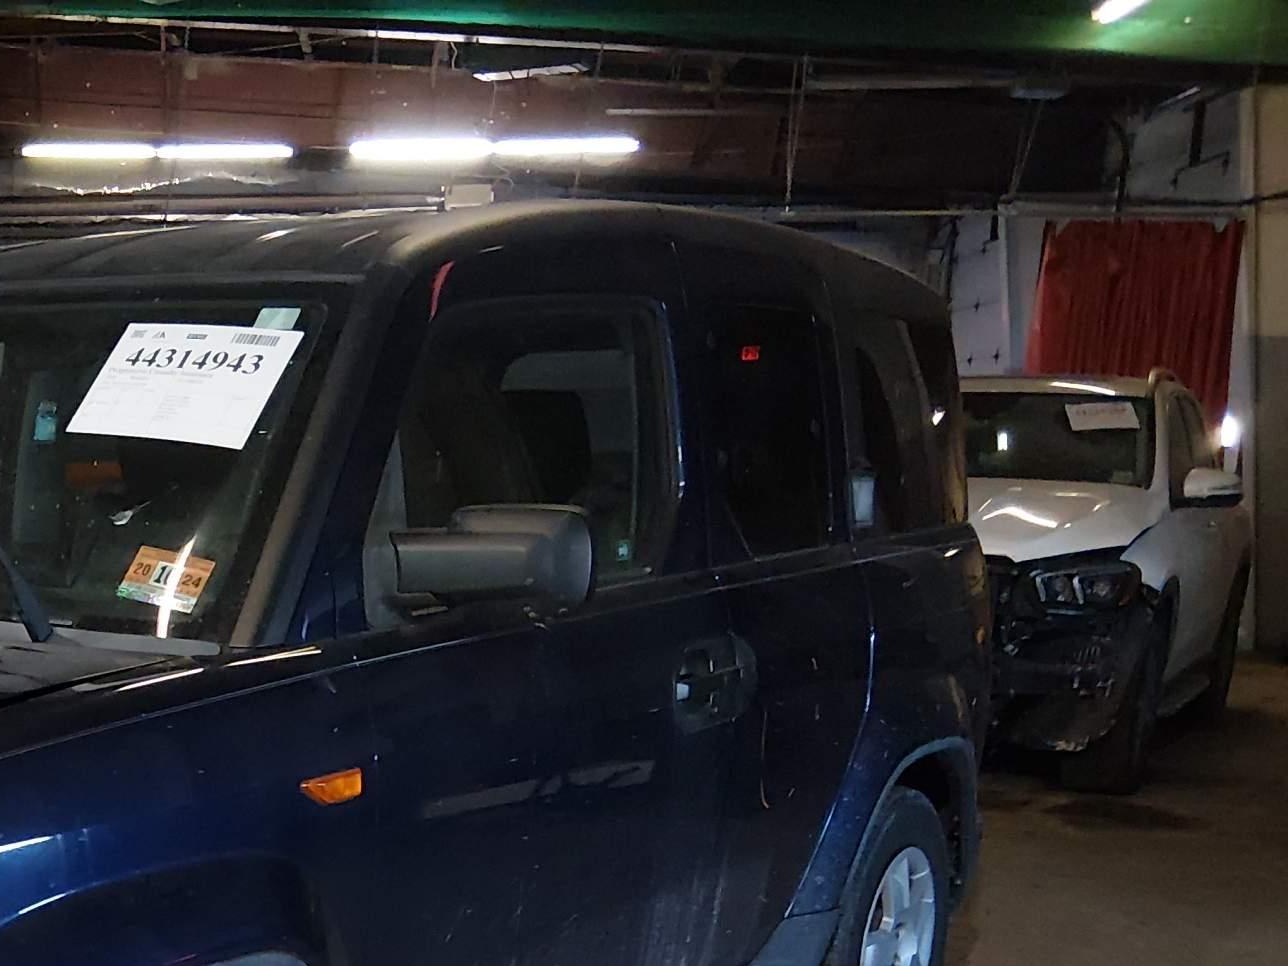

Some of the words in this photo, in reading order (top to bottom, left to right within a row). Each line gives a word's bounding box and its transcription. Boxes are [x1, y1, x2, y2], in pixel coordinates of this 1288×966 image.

[125, 347, 264, 374] 44314943
[133, 562, 152, 576] 20
[182, 575, 202, 588] 24
